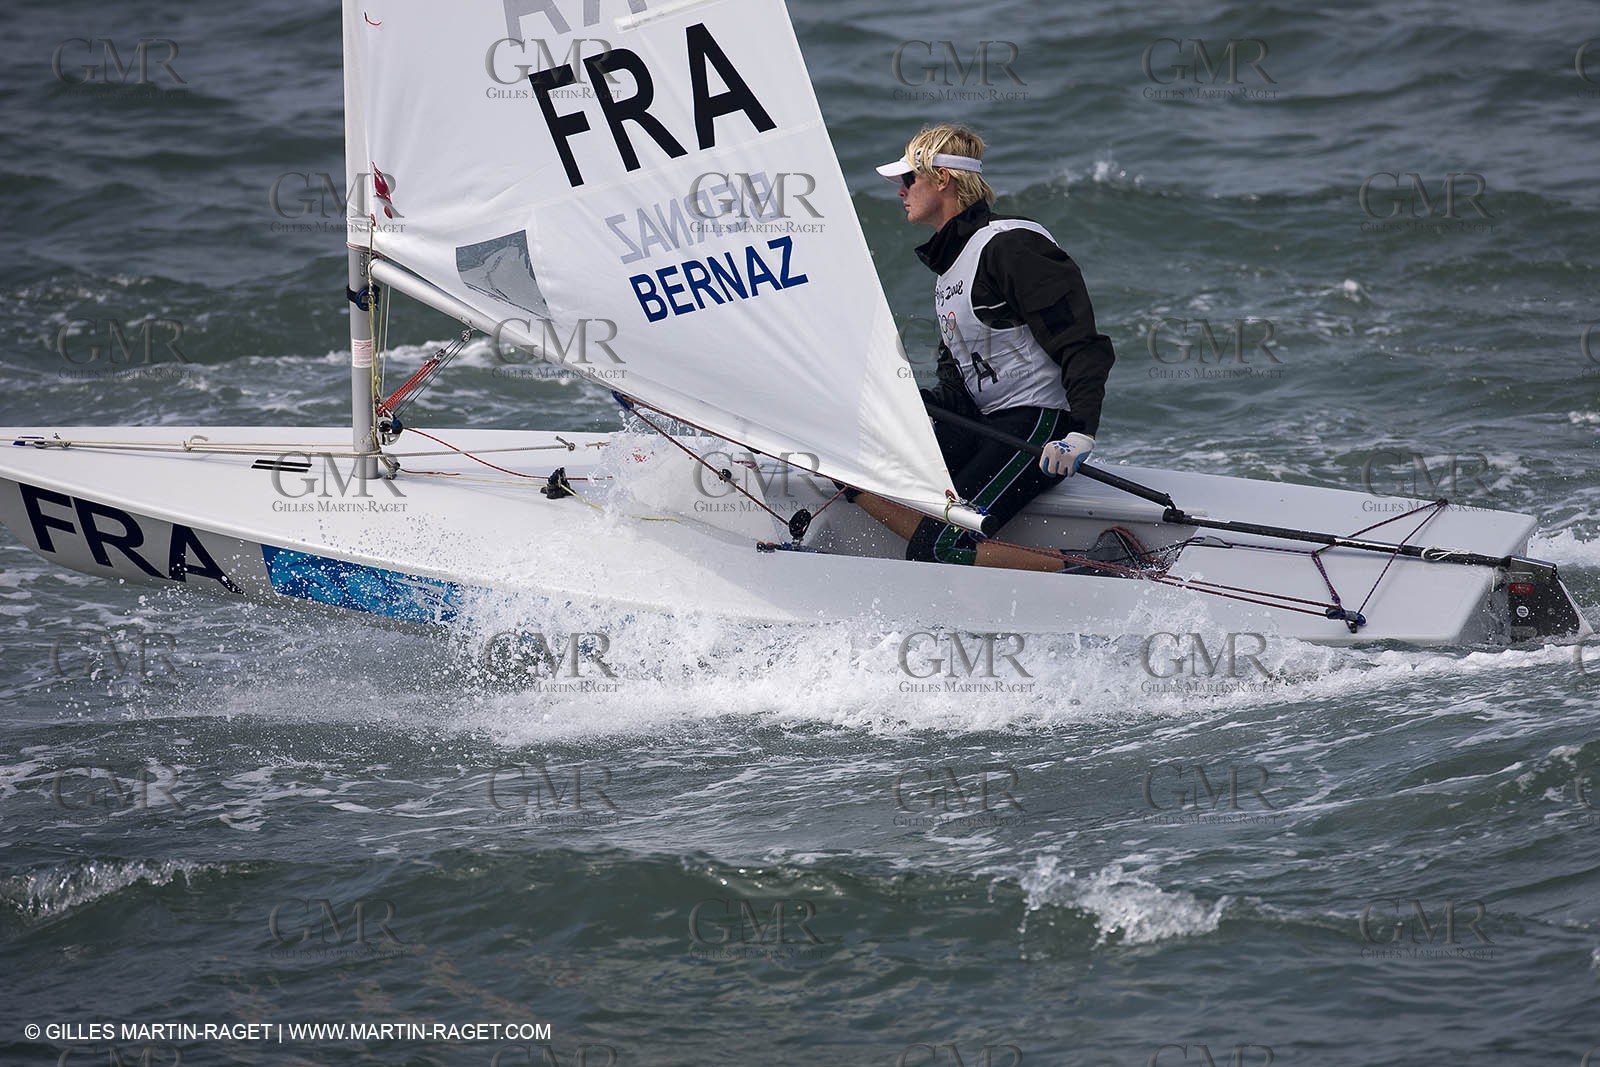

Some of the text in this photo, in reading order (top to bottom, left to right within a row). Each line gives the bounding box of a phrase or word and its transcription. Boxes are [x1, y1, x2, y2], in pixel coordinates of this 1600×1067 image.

[528, 22, 777, 187] FRA
[629, 235, 808, 323] BERNAZ
[945, 279, 963, 300] 2008
[18, 482, 247, 597] FRA
